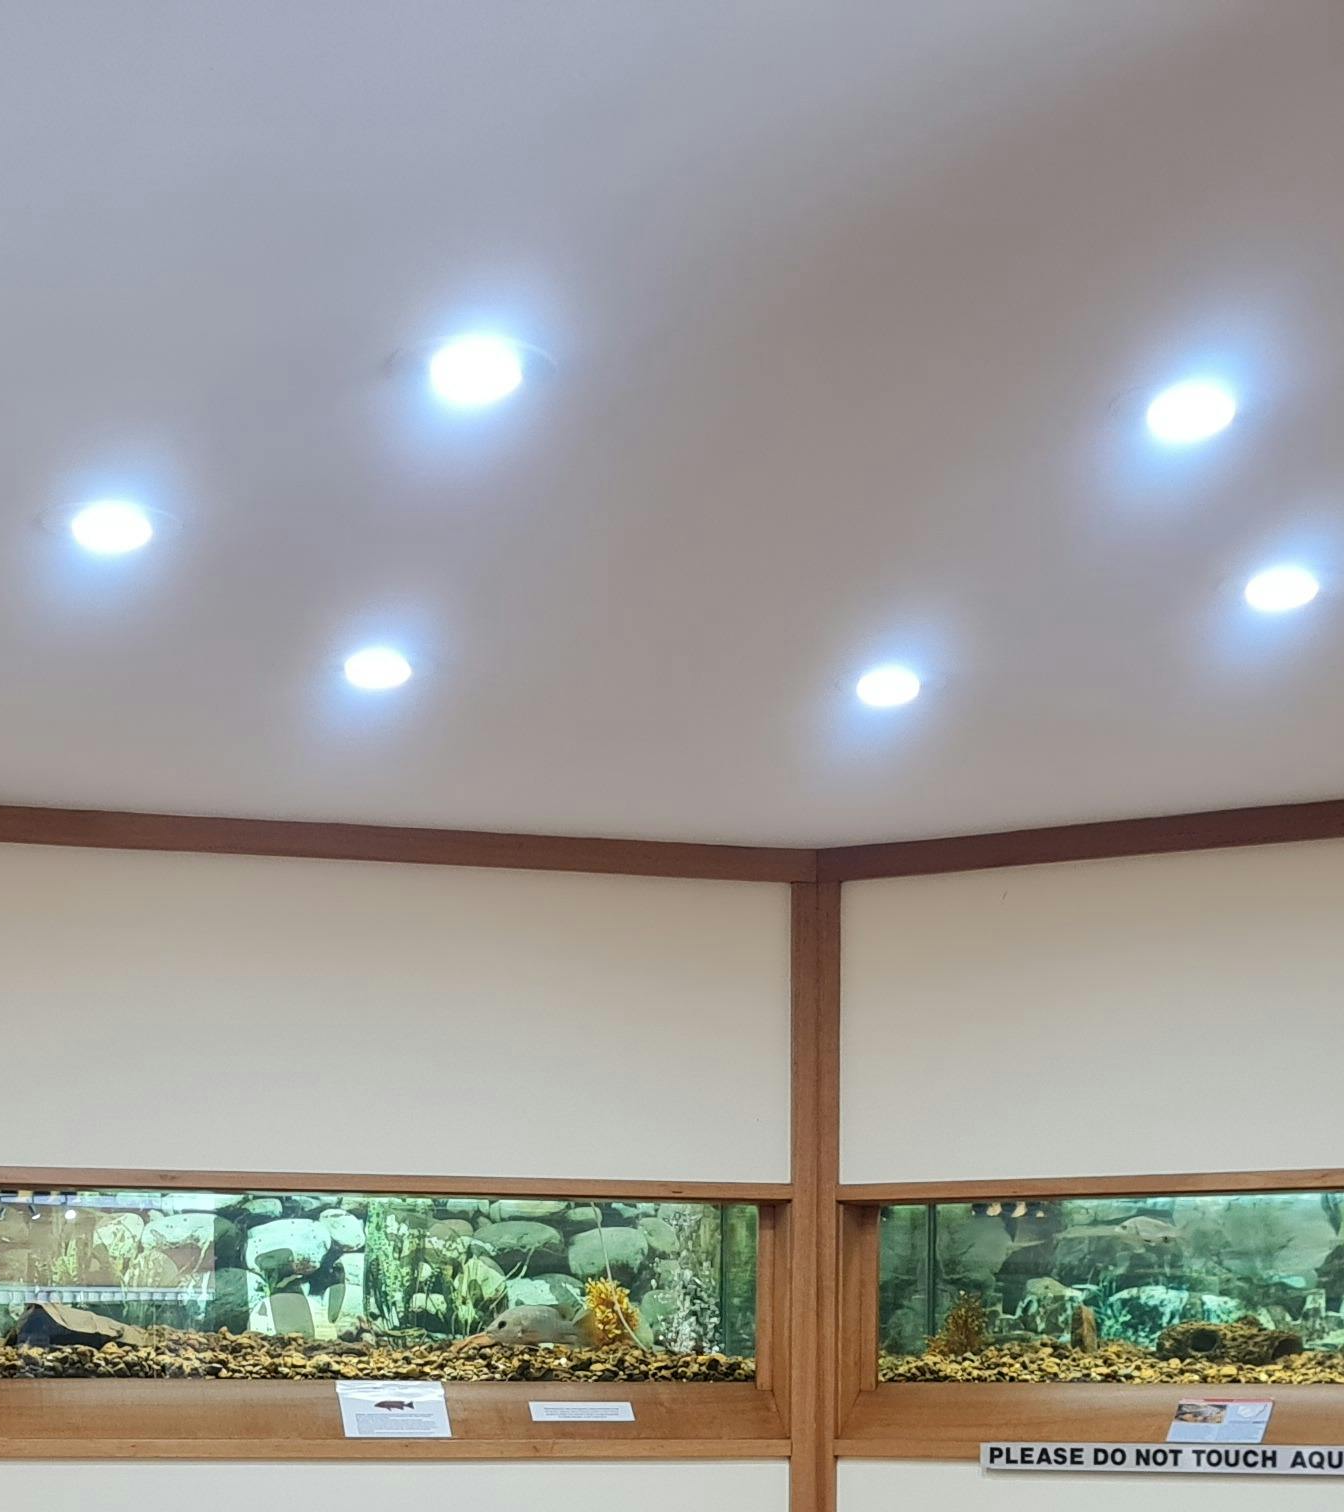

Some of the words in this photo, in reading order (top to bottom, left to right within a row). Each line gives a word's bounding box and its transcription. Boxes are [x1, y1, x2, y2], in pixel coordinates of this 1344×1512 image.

[989, 1446, 1084, 1466] PLEASE
[1093, 1448, 1127, 1467] DO
[1135, 1448, 1183, 1467] NOT
[1192, 1449, 1277, 1468] TOUCH
